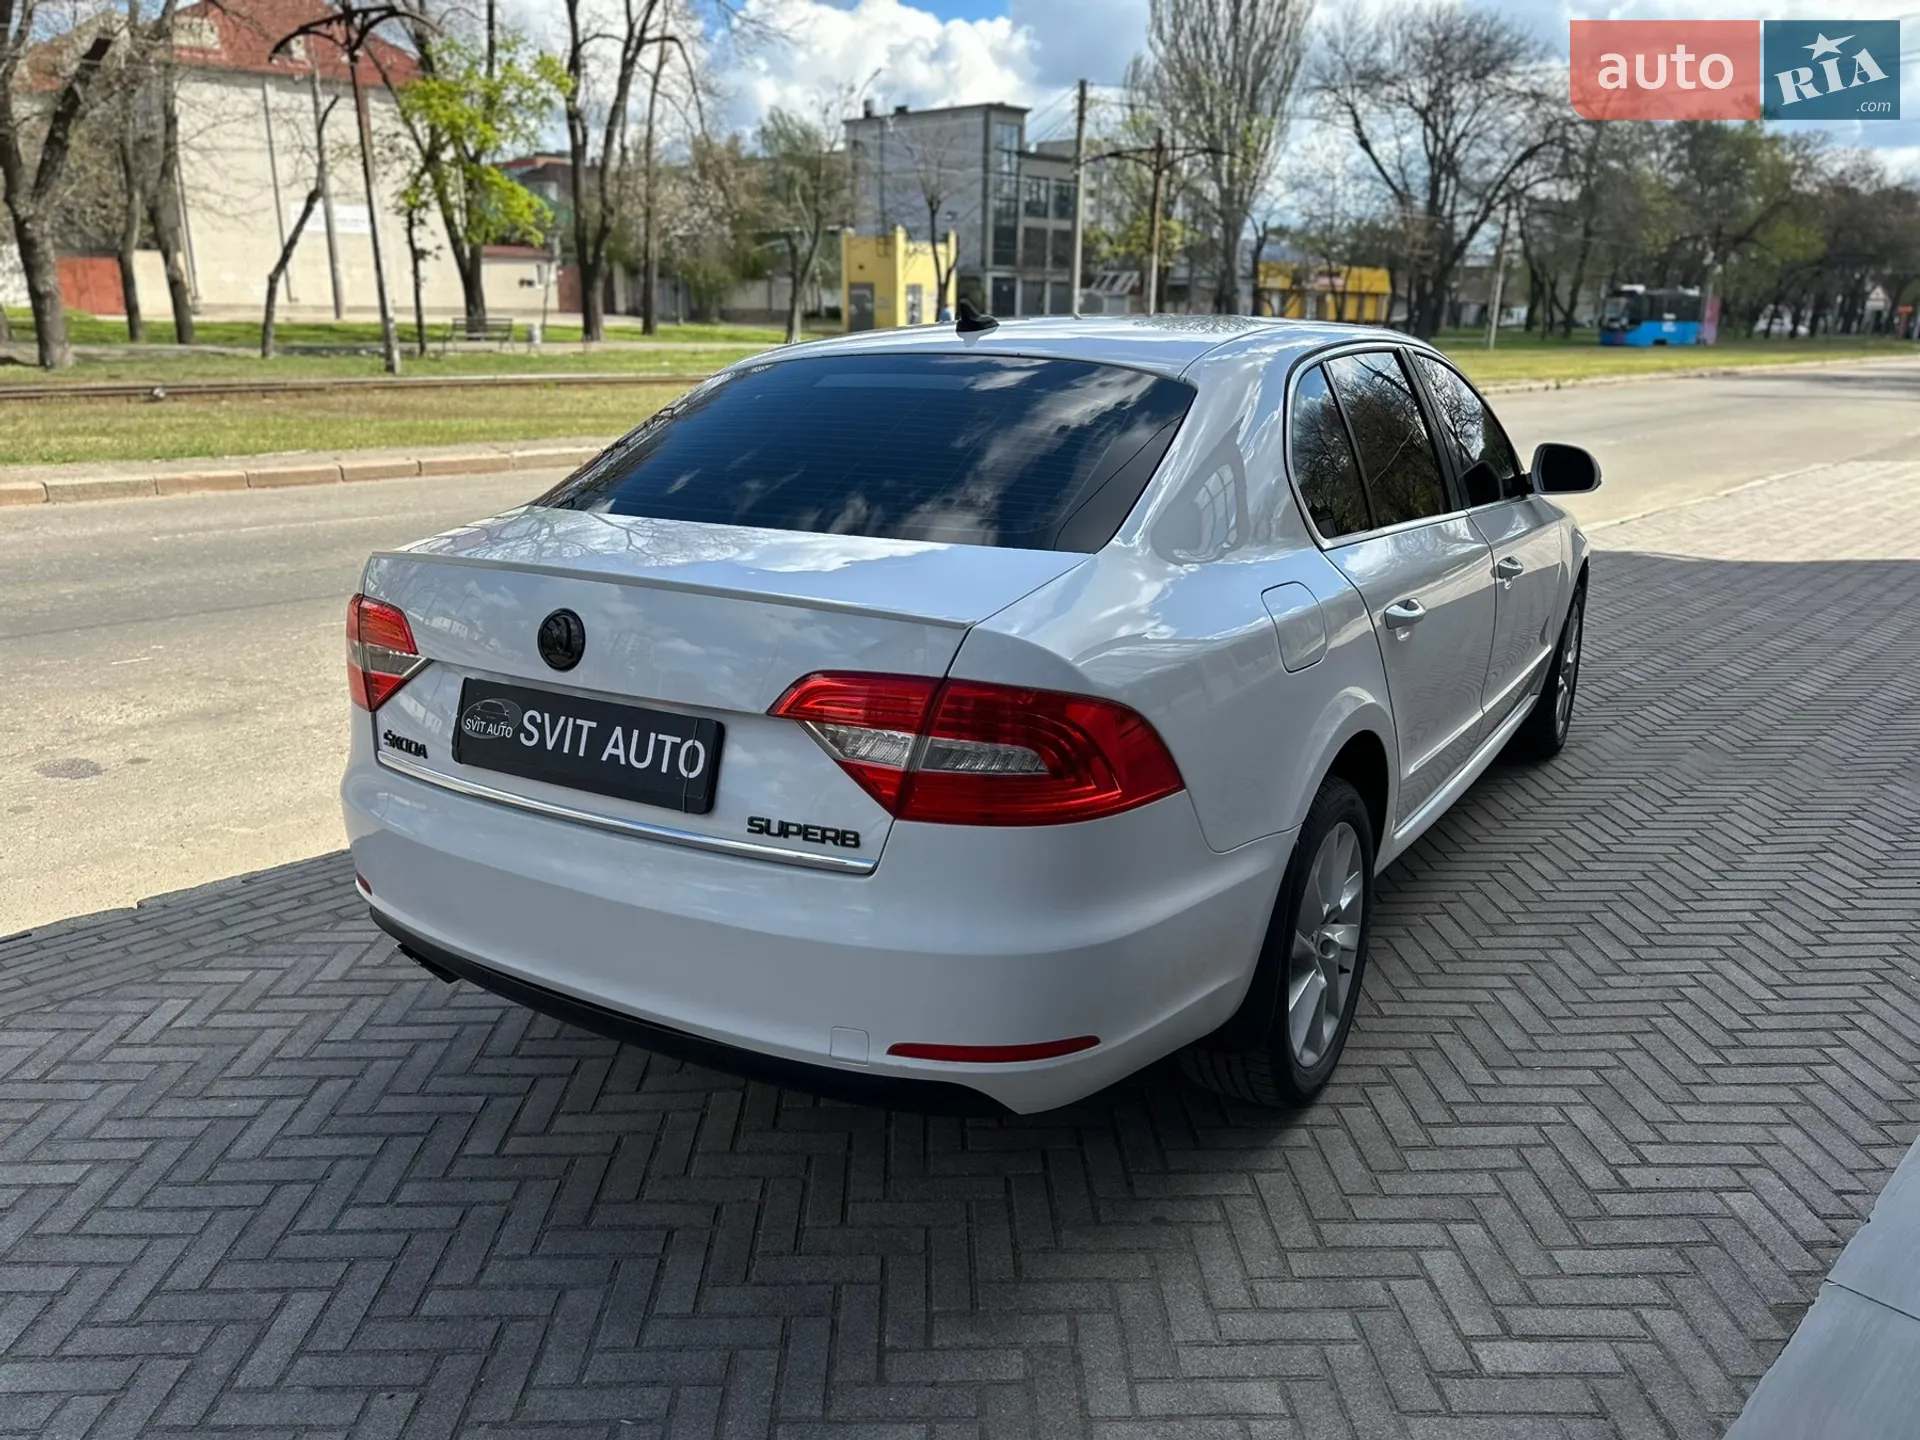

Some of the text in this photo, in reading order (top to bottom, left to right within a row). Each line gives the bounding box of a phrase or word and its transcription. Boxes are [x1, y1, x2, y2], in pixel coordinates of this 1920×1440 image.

[465, 718, 513, 738] SVIT AUTO
[383, 729, 428, 759] ŠKODA
[519, 710, 706, 779] SVIT AUTO
[747, 815, 860, 848] SUPERB
